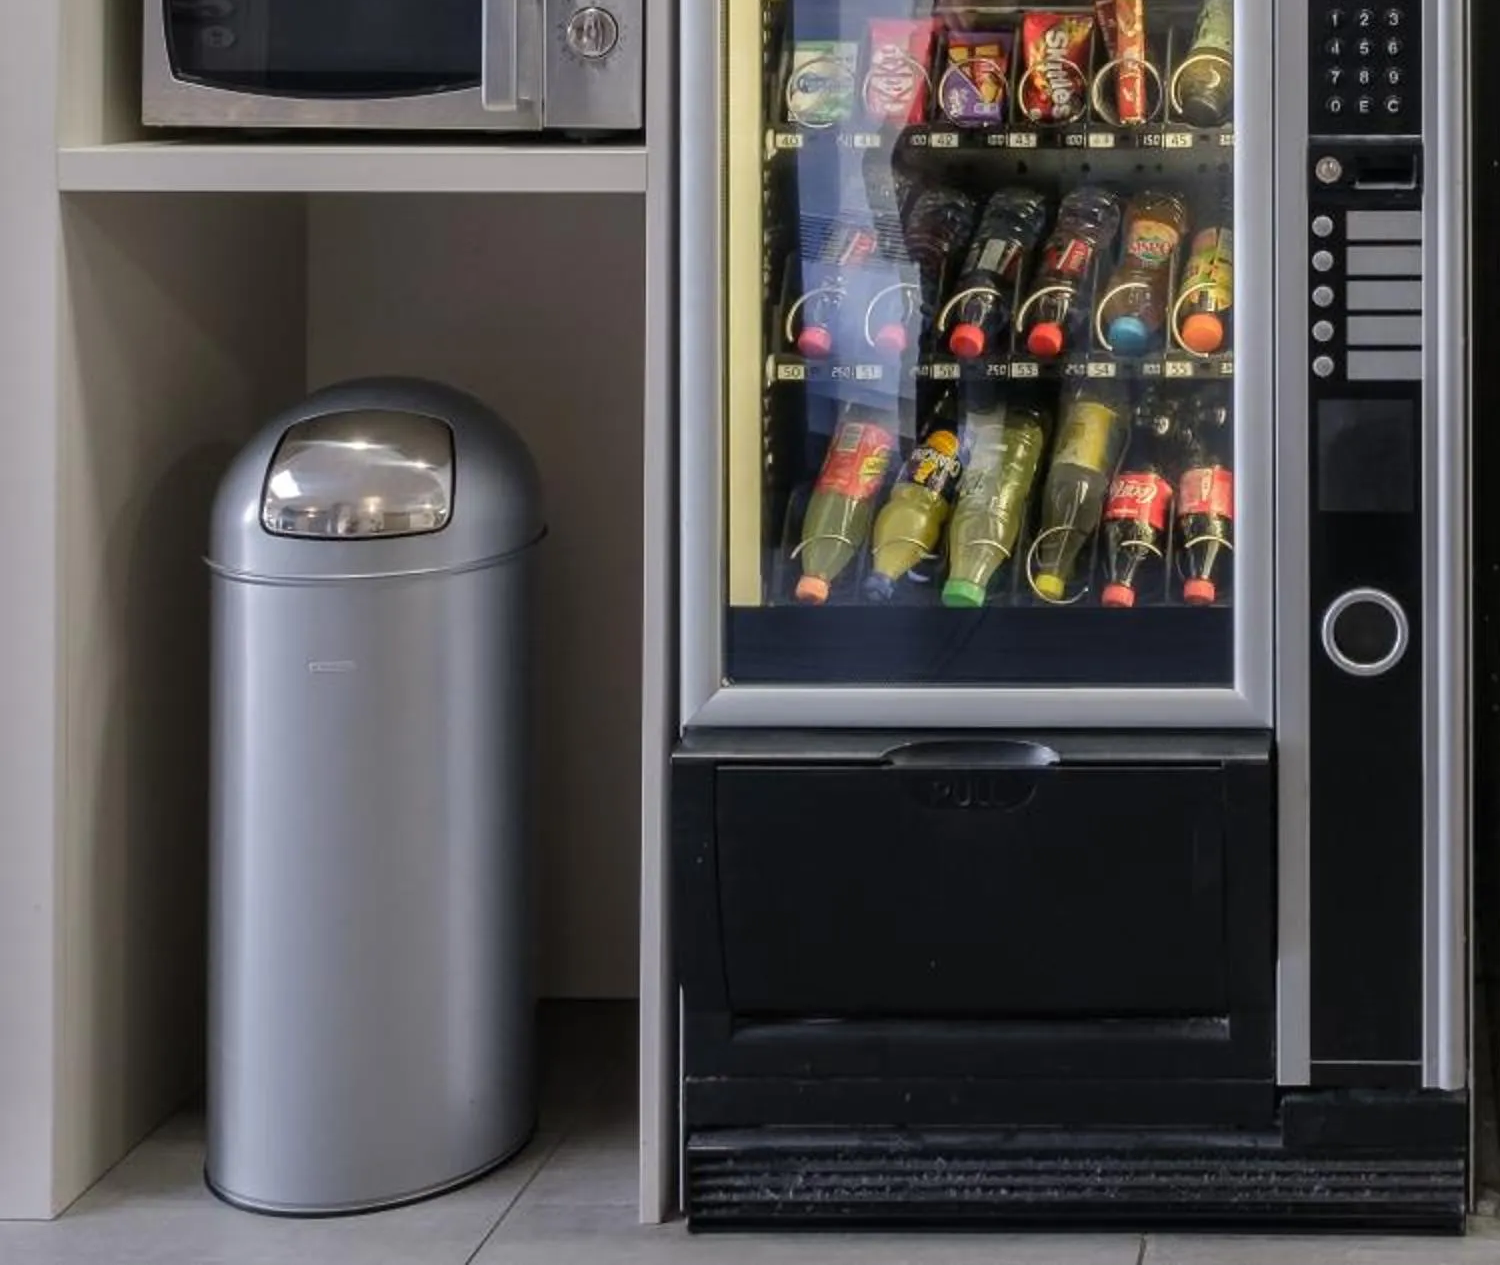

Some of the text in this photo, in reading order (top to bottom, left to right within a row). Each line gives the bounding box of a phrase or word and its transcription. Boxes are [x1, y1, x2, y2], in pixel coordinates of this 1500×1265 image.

[1331, 13, 1399, 26] 1 2 3
[1359, 42, 1370, 55] 5
[1388, 42, 1399, 55] 6
[1045, 30, 1072, 118] Skittles
[1331, 71, 1399, 84] 7 8 9
[1359, 99, 1370, 113] E
[1388, 99, 1399, 113] C
